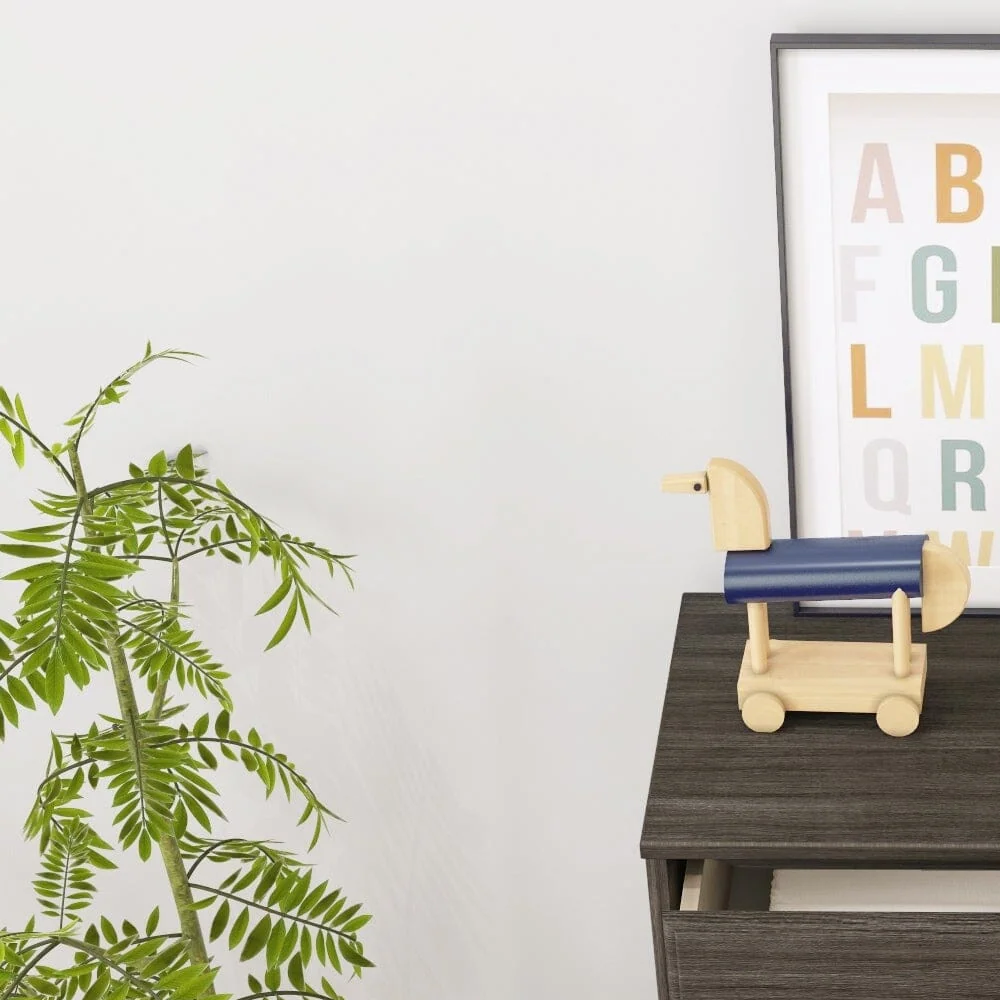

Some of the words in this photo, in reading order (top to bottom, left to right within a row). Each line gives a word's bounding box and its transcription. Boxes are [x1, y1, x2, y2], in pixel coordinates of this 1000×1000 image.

[851, 142, 904, 223] A
[936, 143, 984, 223] B
[839, 245, 880, 322] F
[911, 245, 957, 323] G
[851, 344, 892, 418] L
[921, 344, 985, 419] M
[862, 438, 912, 515] Q
[940, 440, 986, 511] R
